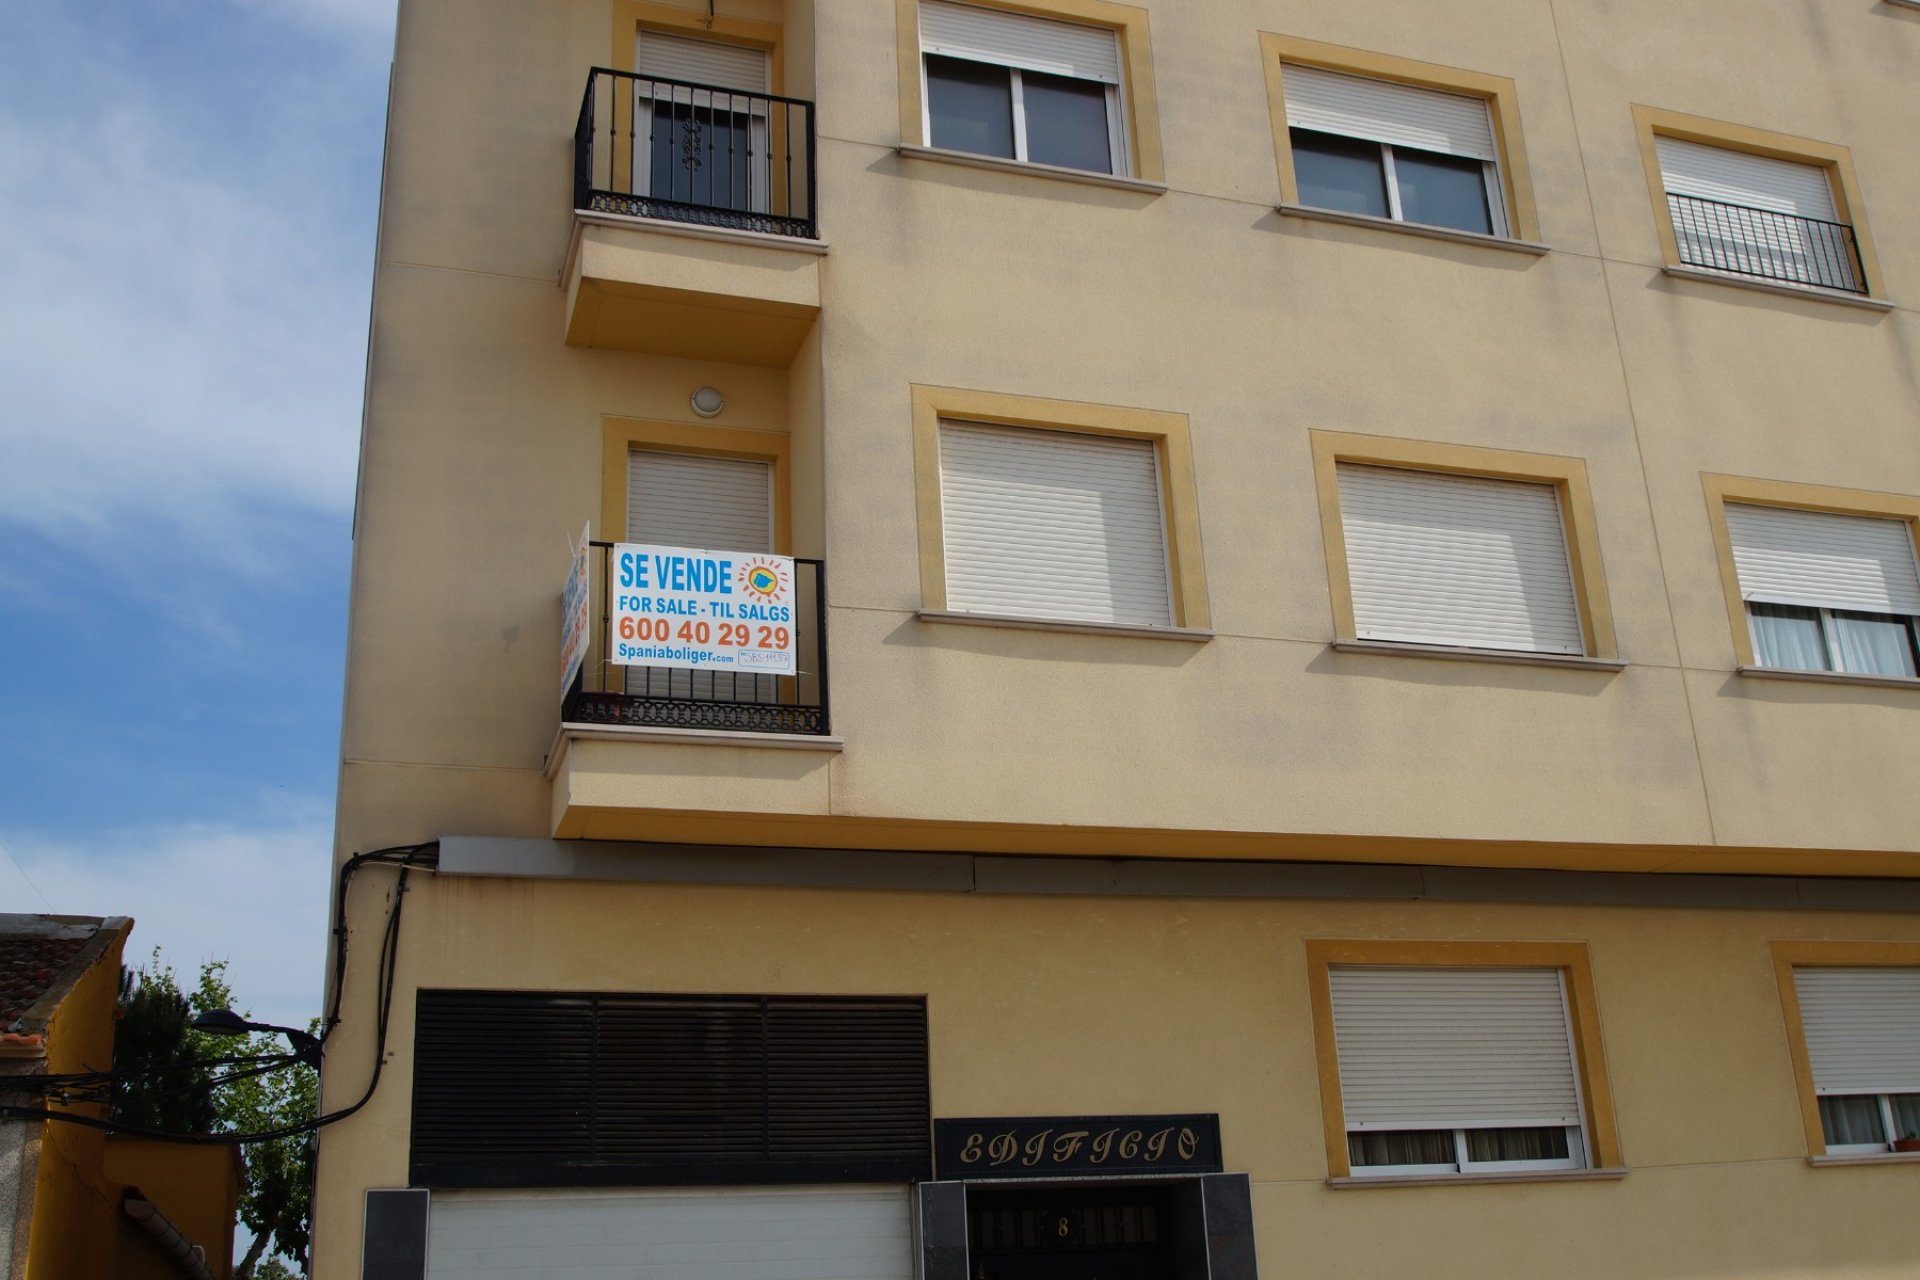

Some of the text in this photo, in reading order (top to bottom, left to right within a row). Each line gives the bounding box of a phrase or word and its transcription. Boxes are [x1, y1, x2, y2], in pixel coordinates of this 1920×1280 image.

[620, 553, 732, 594] SE VENDE
[619, 595, 652, 613] FOR
[656, 598, 697, 616] SALE
[709, 602, 734, 618] TIL
[739, 604, 790, 622] SALGS
[619, 616, 790, 650] 600 40 29 29
[619, 643, 734, 664] Spaniaboliger.com
[960, 1127, 1200, 1167] EDIFICIO
[1058, 1217, 1068, 1237] 8
